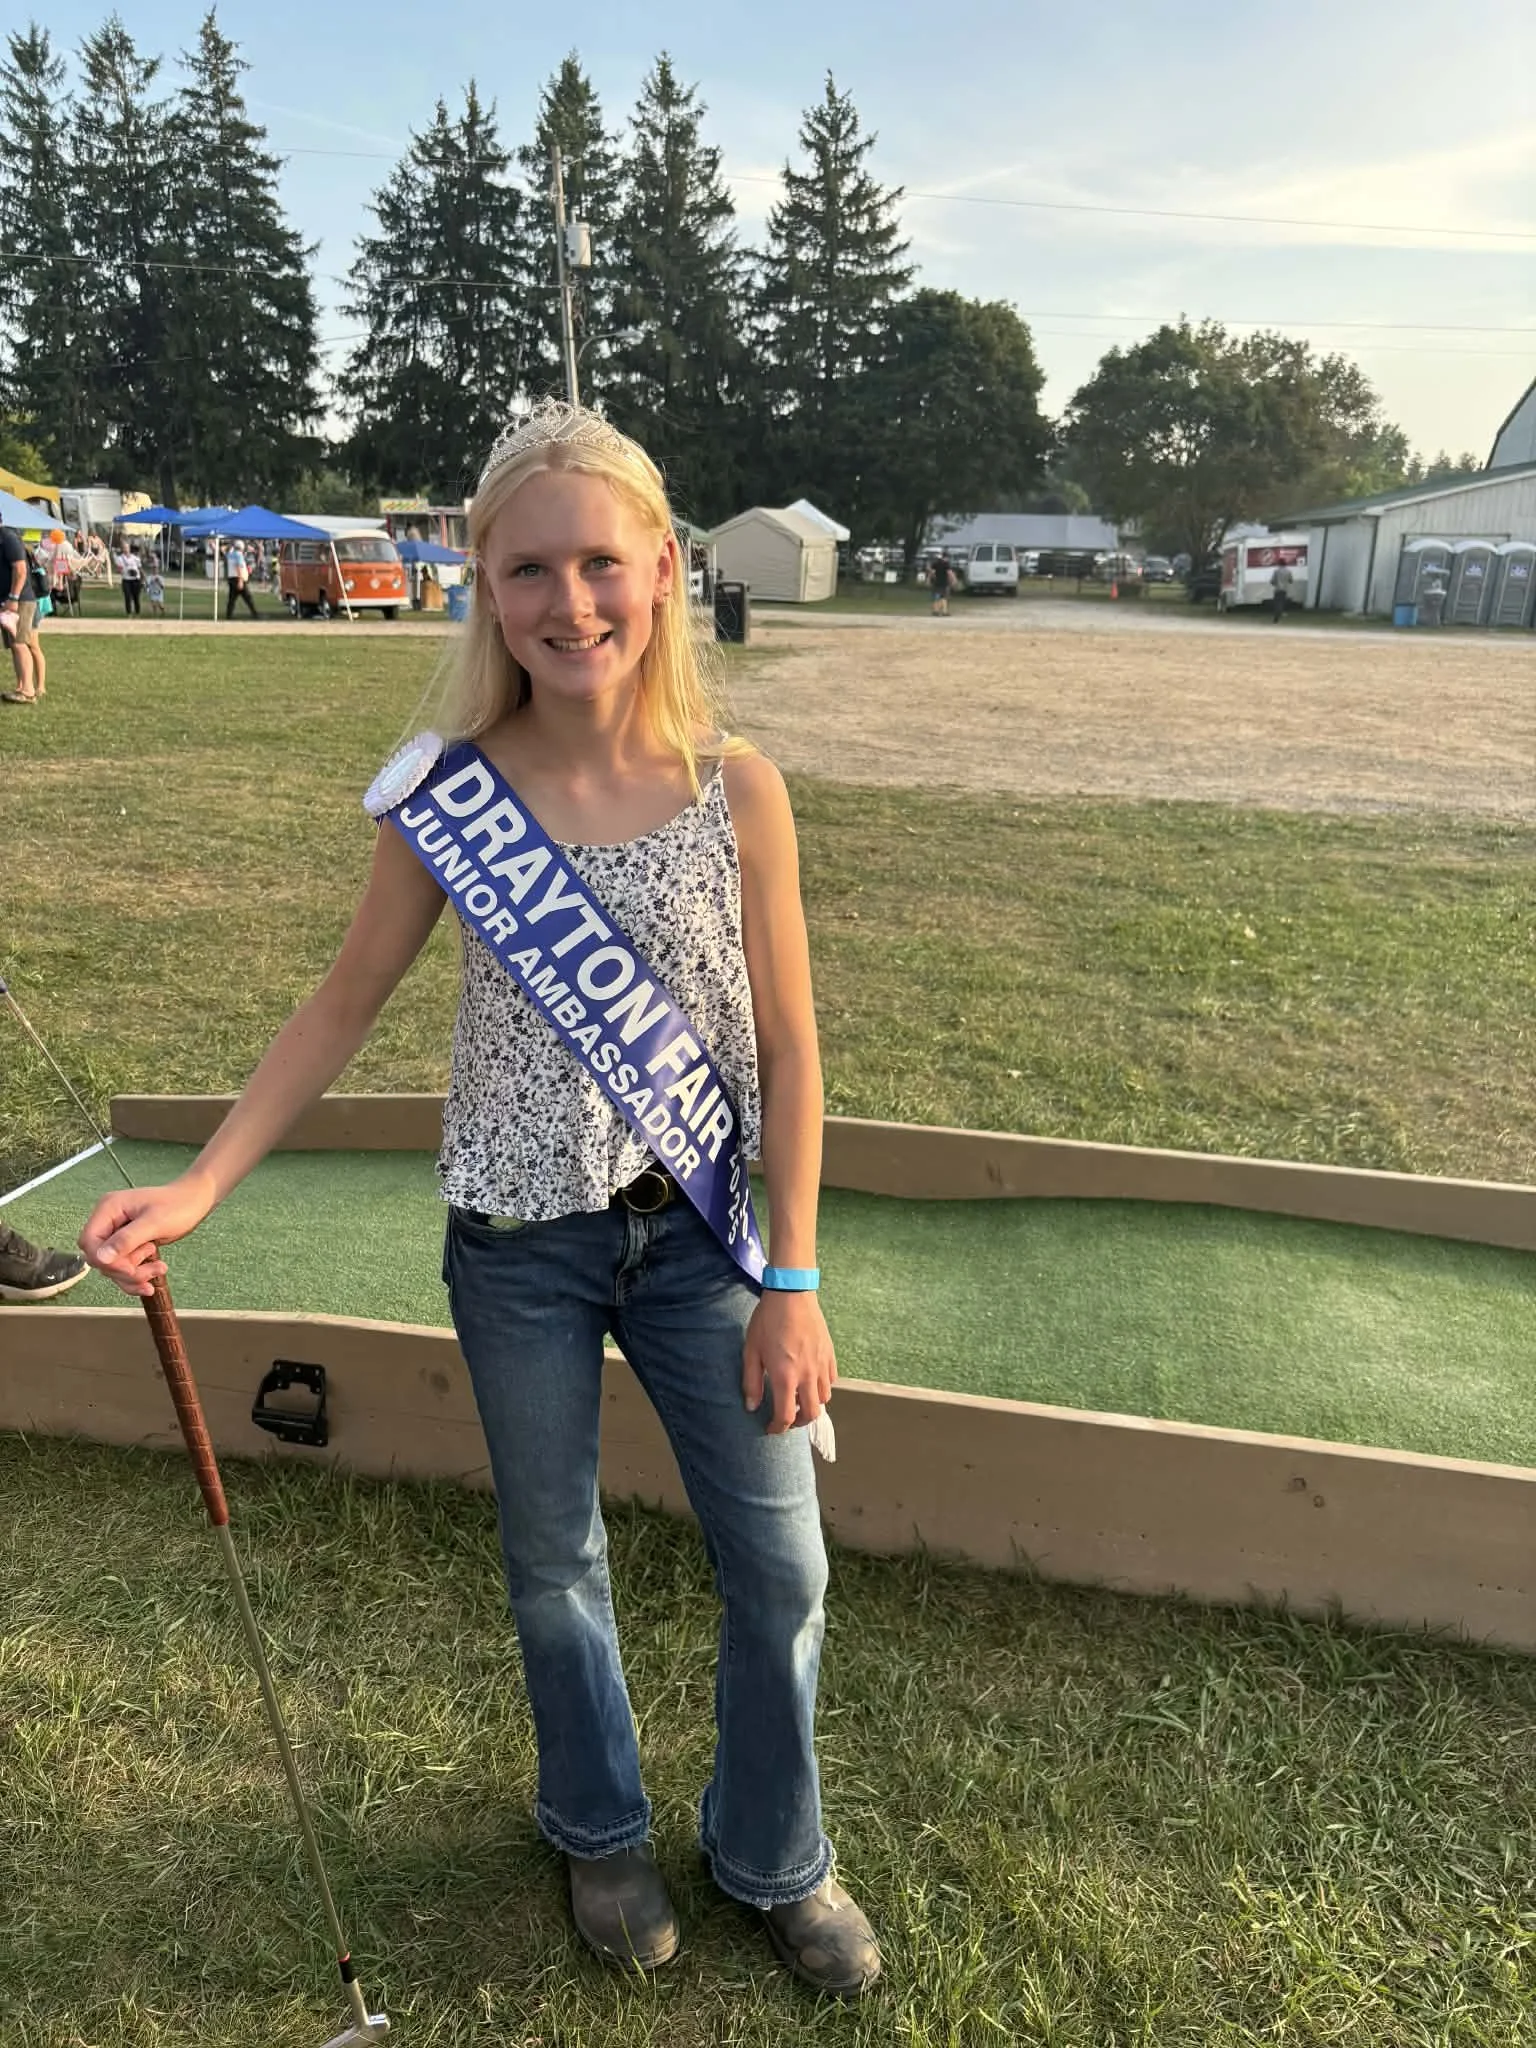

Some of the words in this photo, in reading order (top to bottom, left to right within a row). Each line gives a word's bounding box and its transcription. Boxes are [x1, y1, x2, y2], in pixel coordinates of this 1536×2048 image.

[400, 807, 519, 945] JUNIOR
[508, 947, 700, 1181] AMBASSADOR
[430, 758, 671, 1045] DRAYTON
[645, 1031, 733, 1163] FAIR
